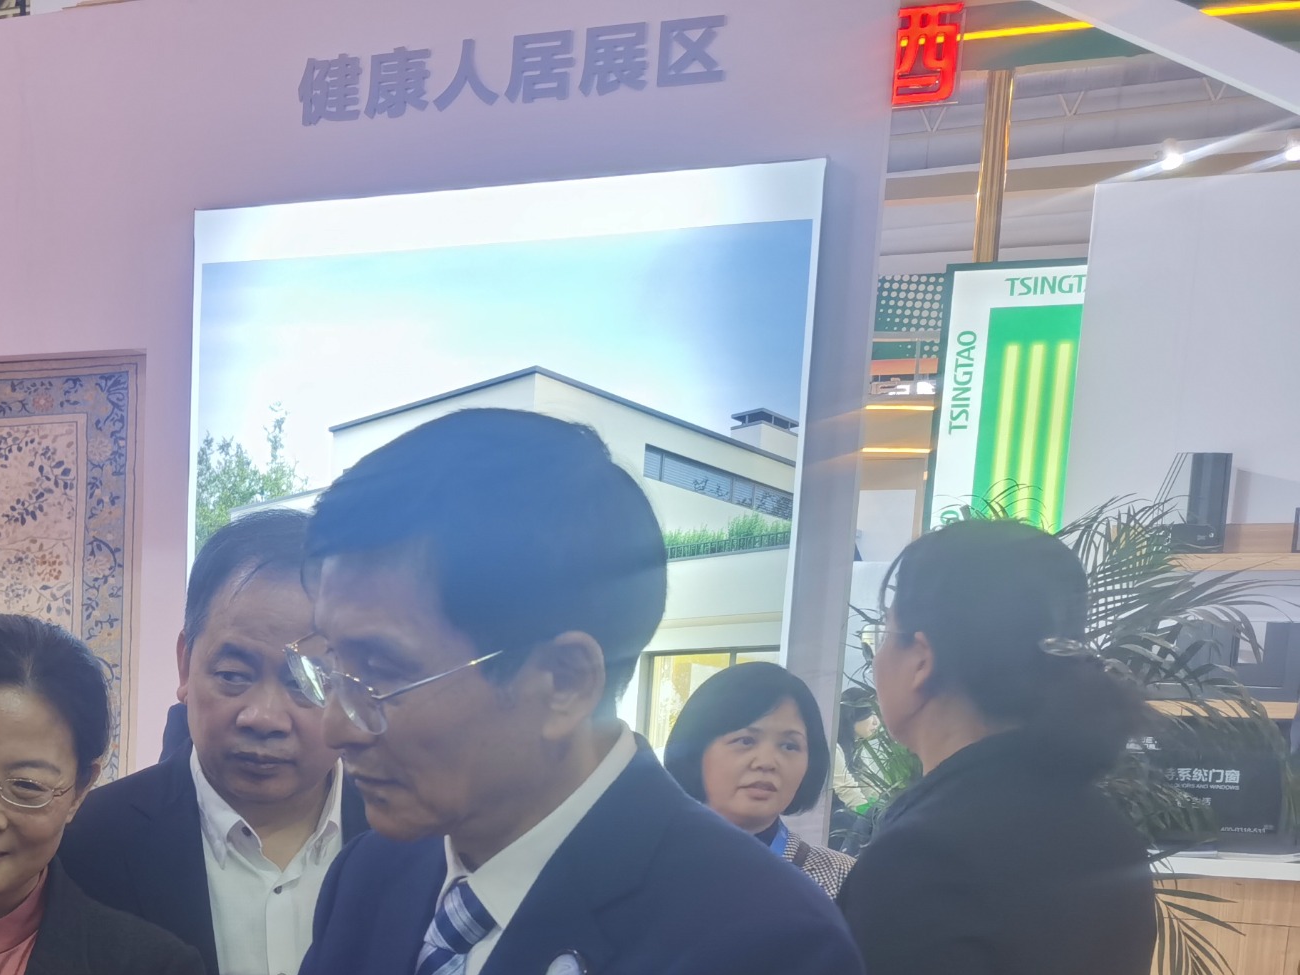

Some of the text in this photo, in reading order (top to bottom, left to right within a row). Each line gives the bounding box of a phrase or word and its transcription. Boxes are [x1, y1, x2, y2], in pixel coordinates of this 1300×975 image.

[298, 14, 726, 126] 健康人居展区
[1004, 274, 1086, 297] TSINGT
[948, 330, 977, 435] TSINGTAO
